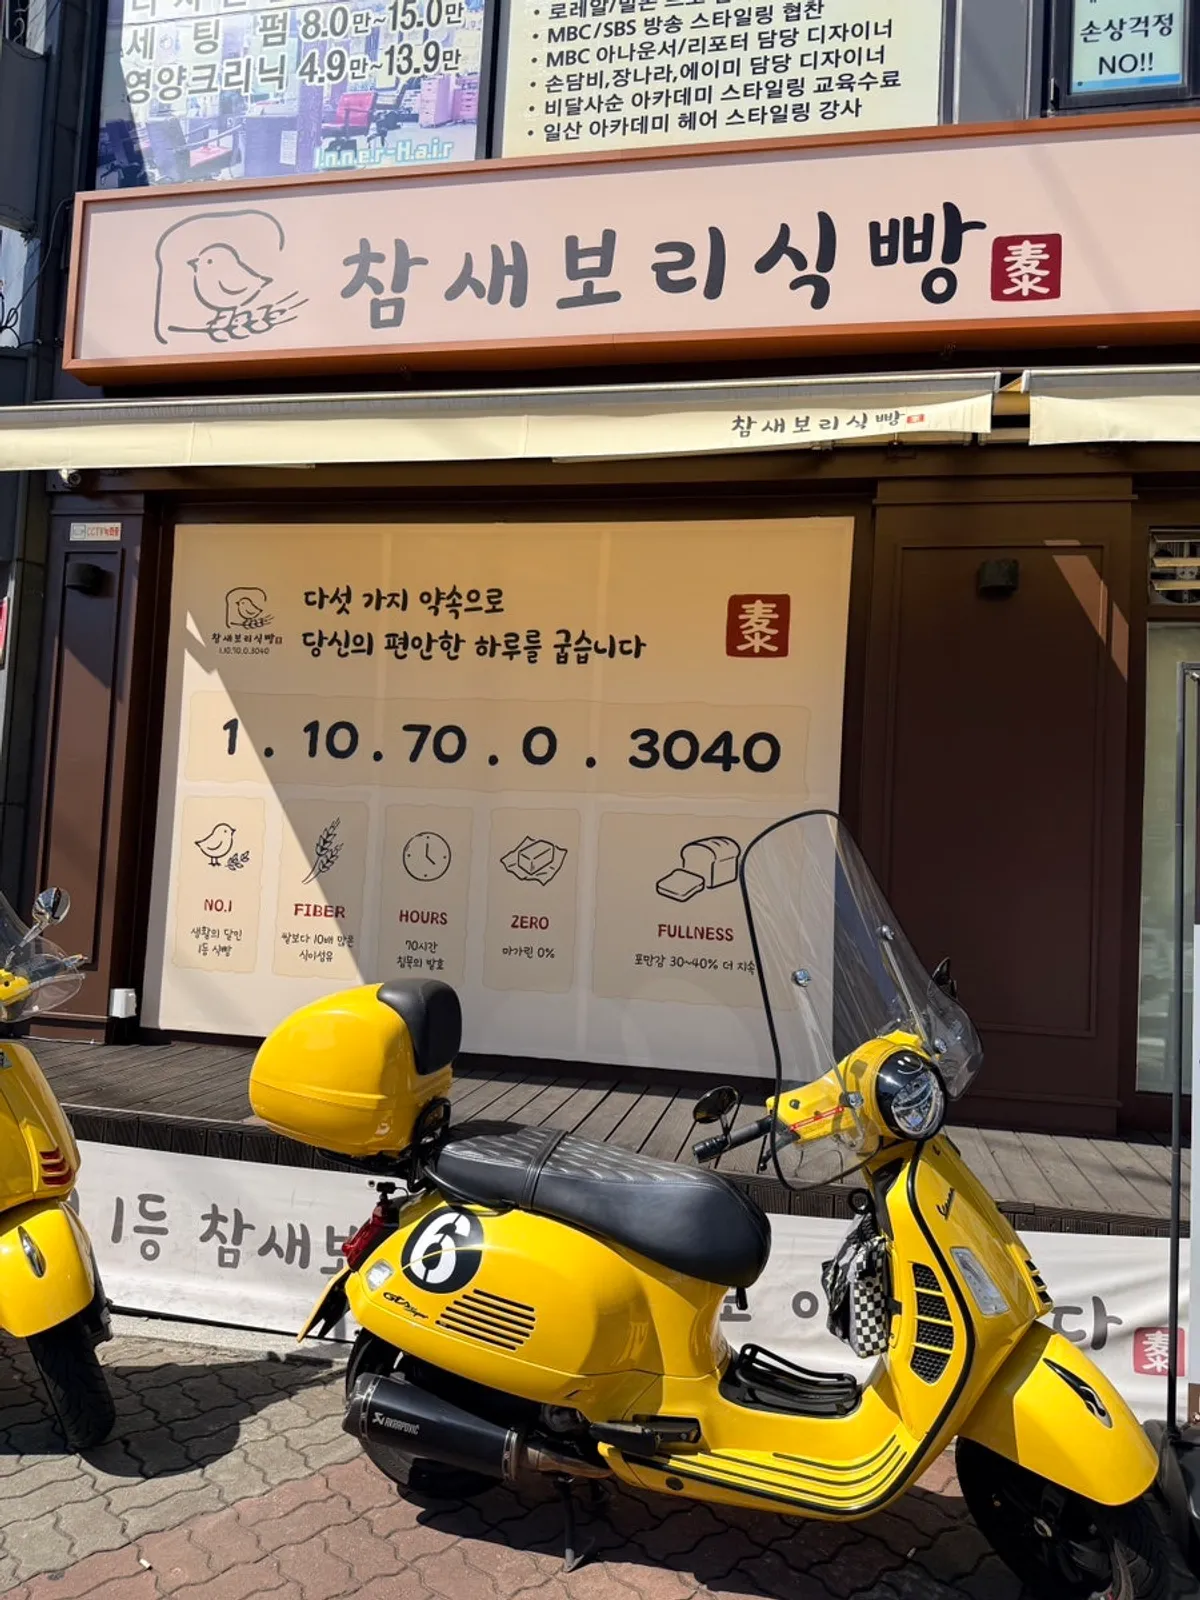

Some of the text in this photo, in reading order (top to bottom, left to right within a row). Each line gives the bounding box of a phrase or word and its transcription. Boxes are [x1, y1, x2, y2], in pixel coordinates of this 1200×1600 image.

[547, 0, 825, 43] MBC/SBS 방송 스타일링 협찬
[1080, 13, 1174, 43] 손상걱정
[546, 19, 893, 67] MBC 아나운서/리포터 담당 디자이너
[545, 45, 885, 93] 손담비,장나라,에이미 담당 디자이너
[1098, 52, 1154, 75] NO!!
[125, 54, 286, 104] 영양크리닉
[545, 70, 901, 117] 비달사순 아카데미 스타일링 교육수료
[543, 98, 862, 142] 일산 아카데미 헤어 스타일링 강사
[304, 585, 504, 620] 다섯 가지 약속으로
[302, 629, 647, 664] 당신의 편안한 하루를 굽습니다
[628, 728, 780, 773] 3040
[294, 904, 346, 918] FIBER
[399, 910, 448, 925] HOURS
[510, 915, 550, 930] ZERO
[223, 928, 243, 941] 달인
[405, 940, 438, 954] 70시간
[657, 924, 734, 942] FULLNESS
[502, 946, 555, 959] 마가린 0%
[669, 956, 718, 971] 30~40%
[722, 960, 734, 971] 더
